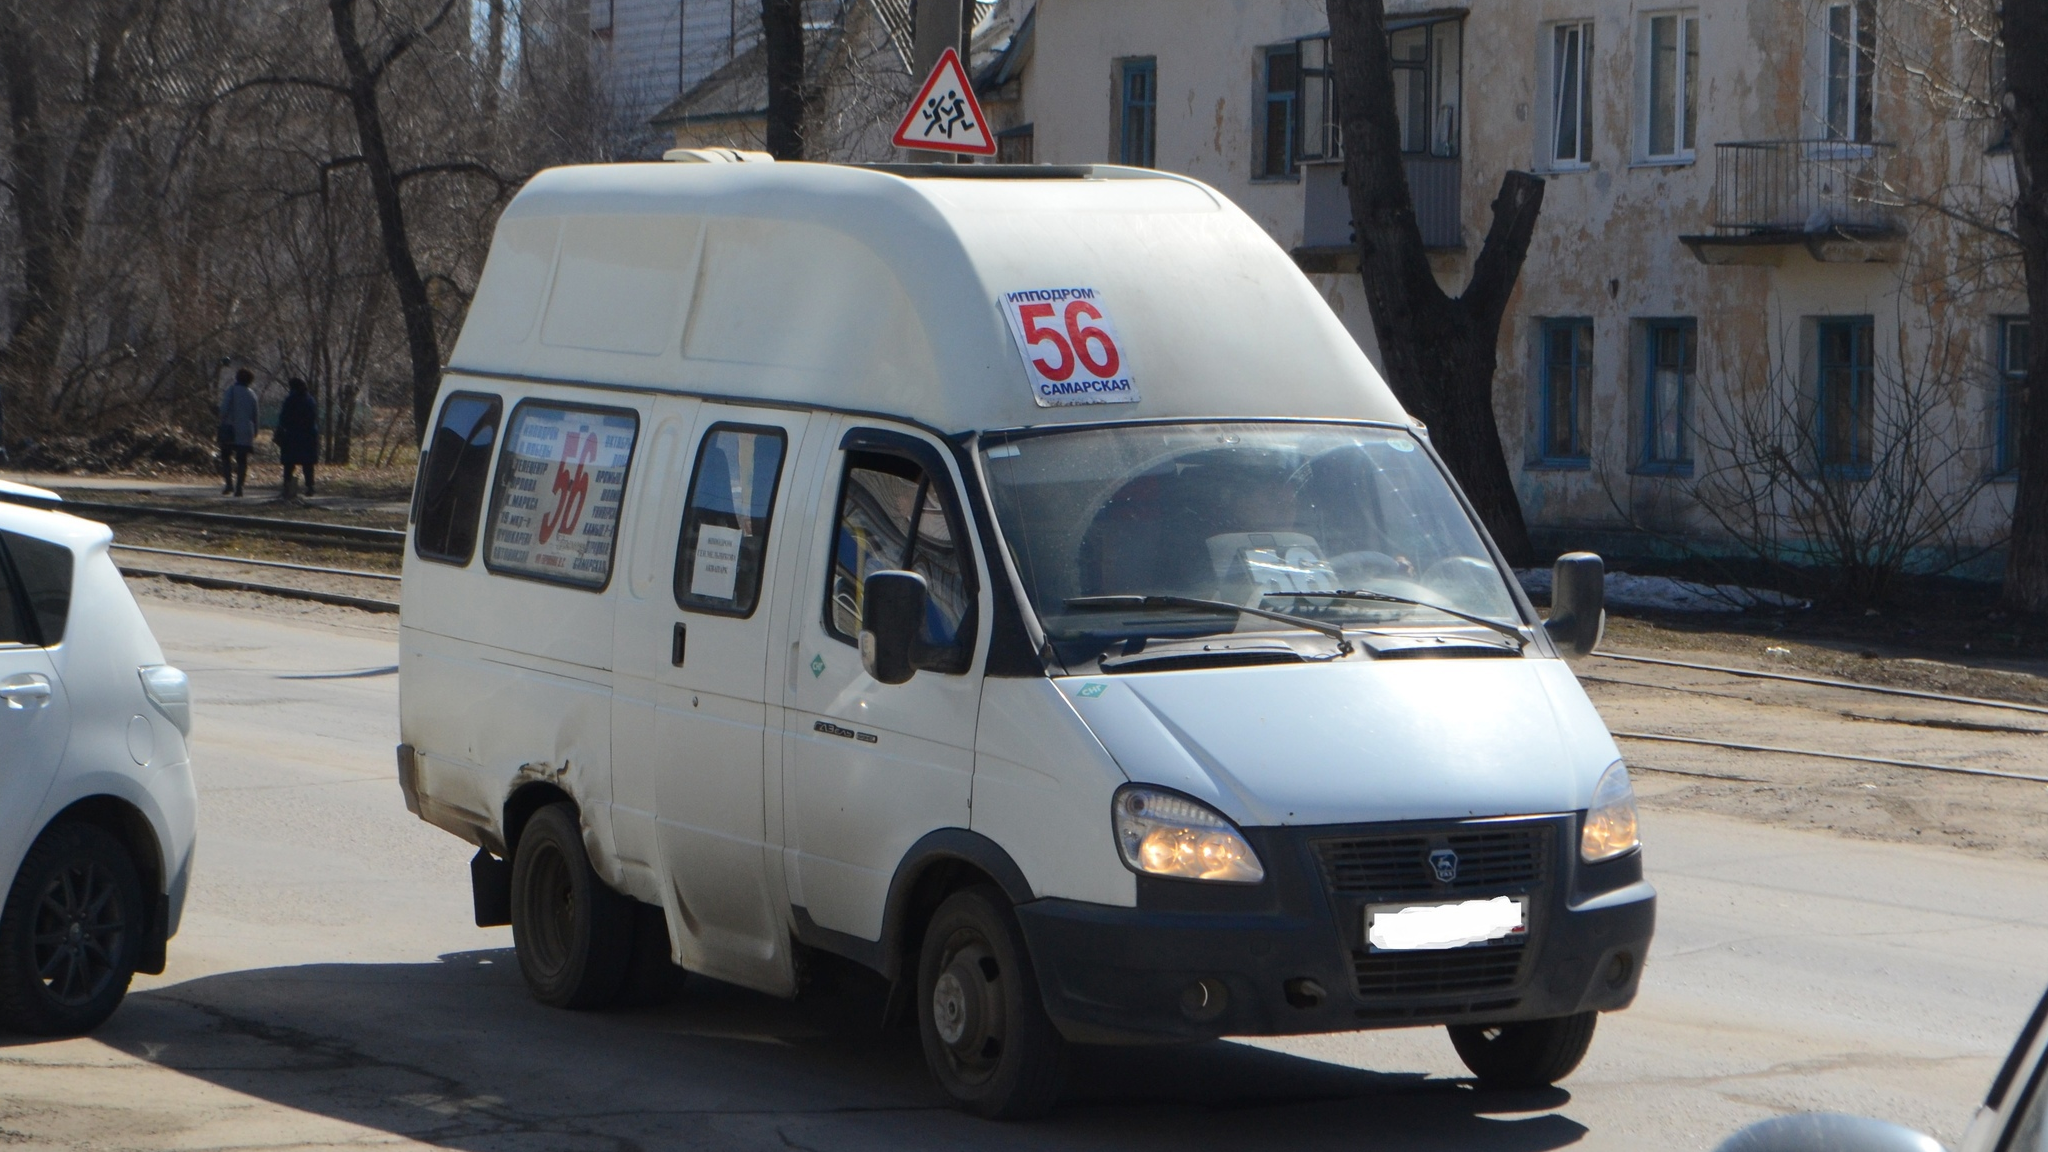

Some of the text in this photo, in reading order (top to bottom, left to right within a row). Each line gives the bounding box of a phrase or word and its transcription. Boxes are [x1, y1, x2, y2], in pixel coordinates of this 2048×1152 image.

[1007, 288, 1095, 303] ИППОДРОМ
[1018, 300, 1120, 382] 56
[1040, 379, 1131, 396] САМАРСКАЯ
[539, 431, 598, 546] 56
